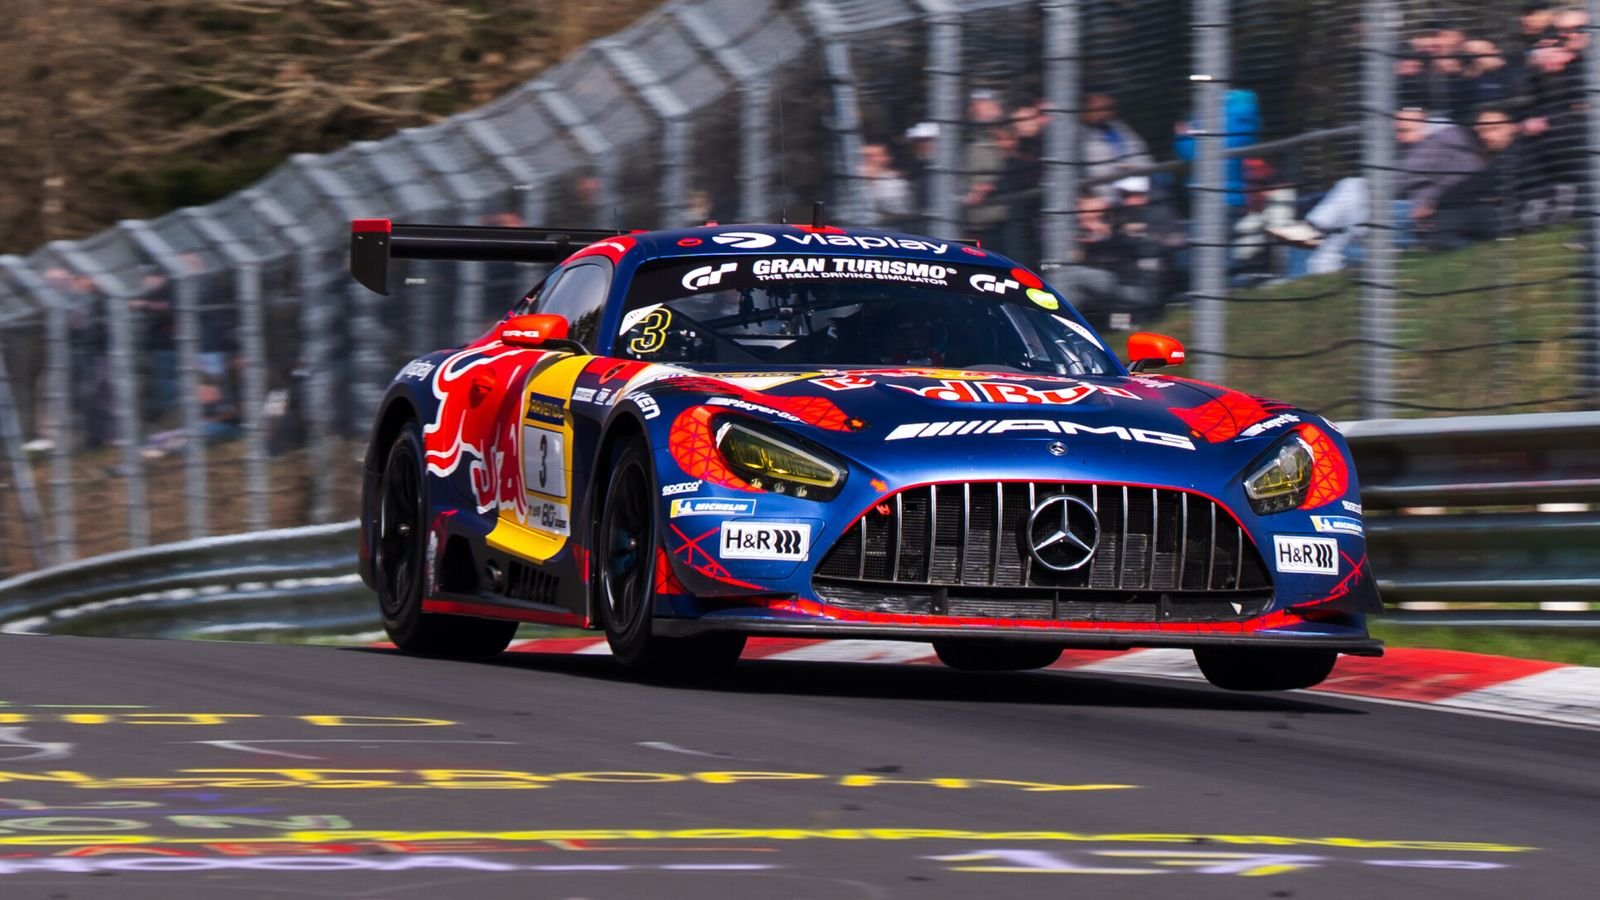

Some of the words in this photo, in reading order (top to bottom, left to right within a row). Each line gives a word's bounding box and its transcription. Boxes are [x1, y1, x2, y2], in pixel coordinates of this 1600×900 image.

[783, 233, 949, 254] viaplay
[752, 257, 826, 275] GRAN
[821, 272, 873, 280] DRIVING
[875, 273, 948, 286] SIMULATOR
[630, 307, 673, 353] 3
[993, 418, 1197, 450] AMG
[538, 433, 548, 489] 3
[662, 481, 700, 496] sparco
[694, 502, 749, 511] MICHELIN
[726, 528, 771, 550] H&R
[1279, 542, 1313, 564] H&R
